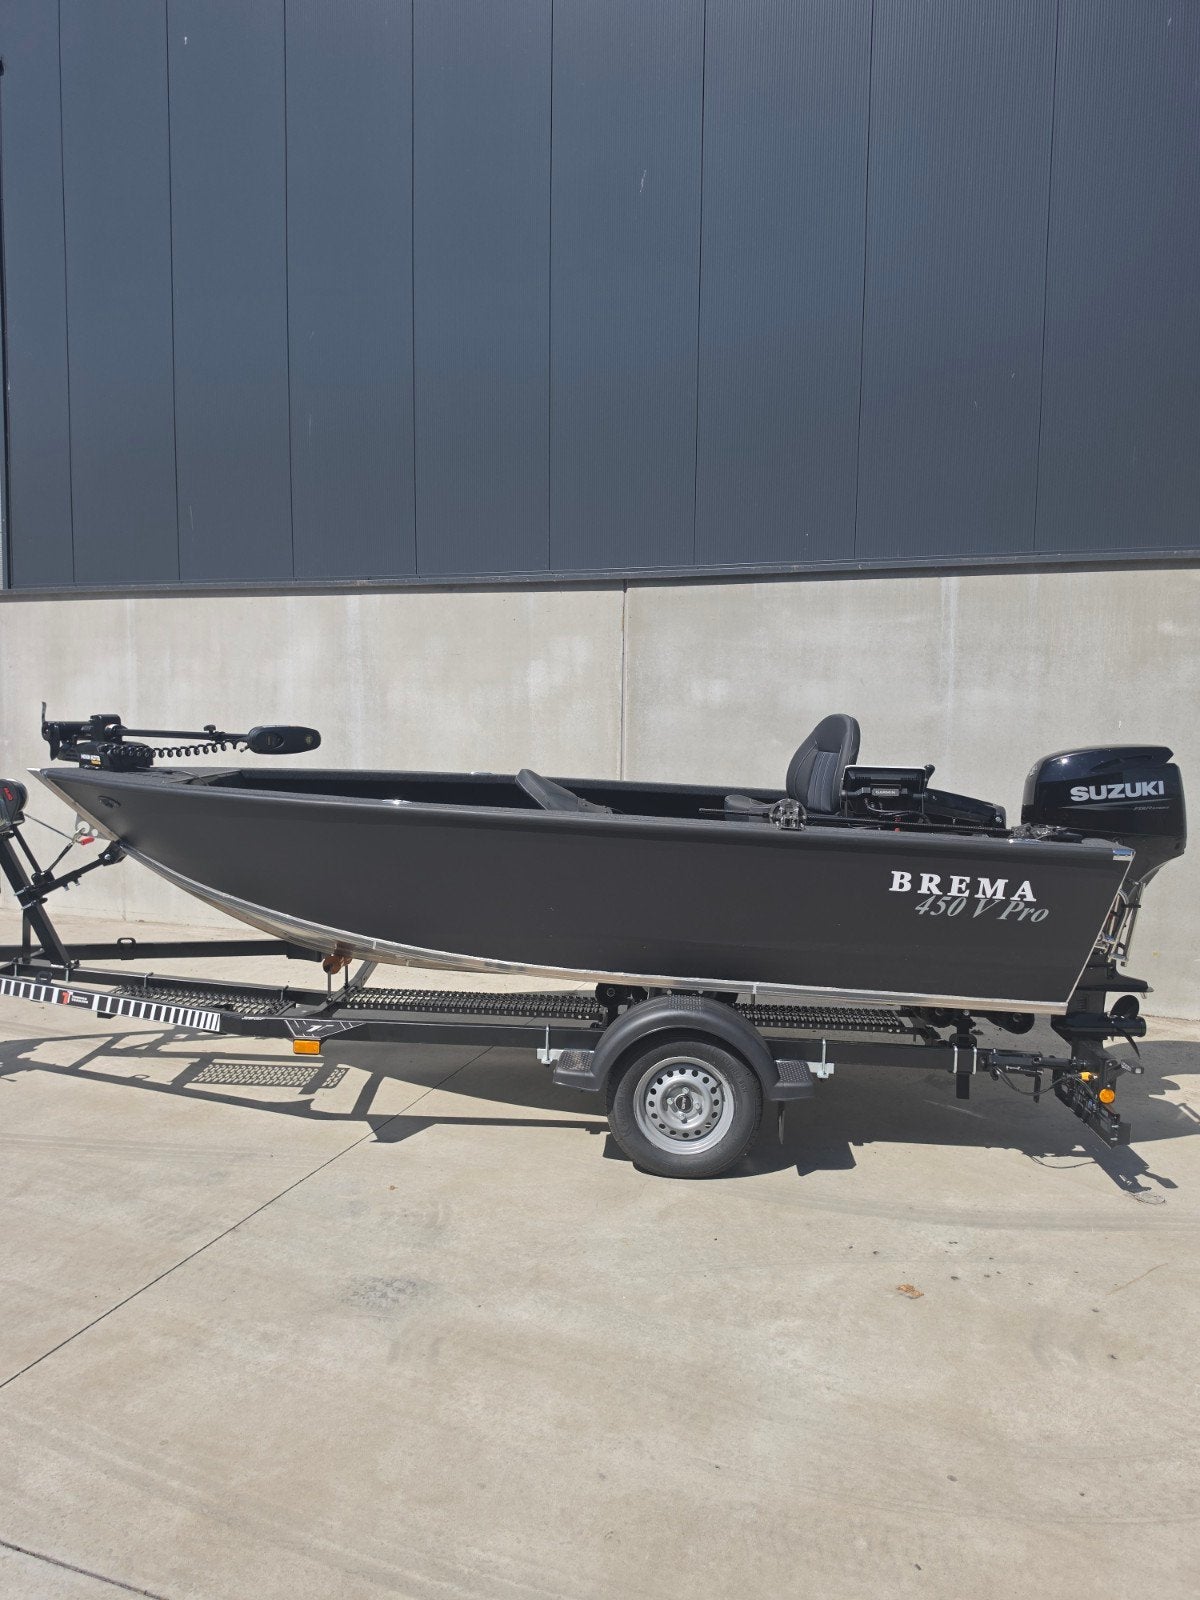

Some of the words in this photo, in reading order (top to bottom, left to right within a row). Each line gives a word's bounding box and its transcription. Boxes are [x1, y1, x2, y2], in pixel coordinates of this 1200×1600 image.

[1070, 781, 1165, 802] SUZUKI
[889, 870, 1037, 902] BREMA
[915, 895, 967, 917] 450
[973, 898, 1001, 918] V
[997, 900, 1049, 922] Pro
